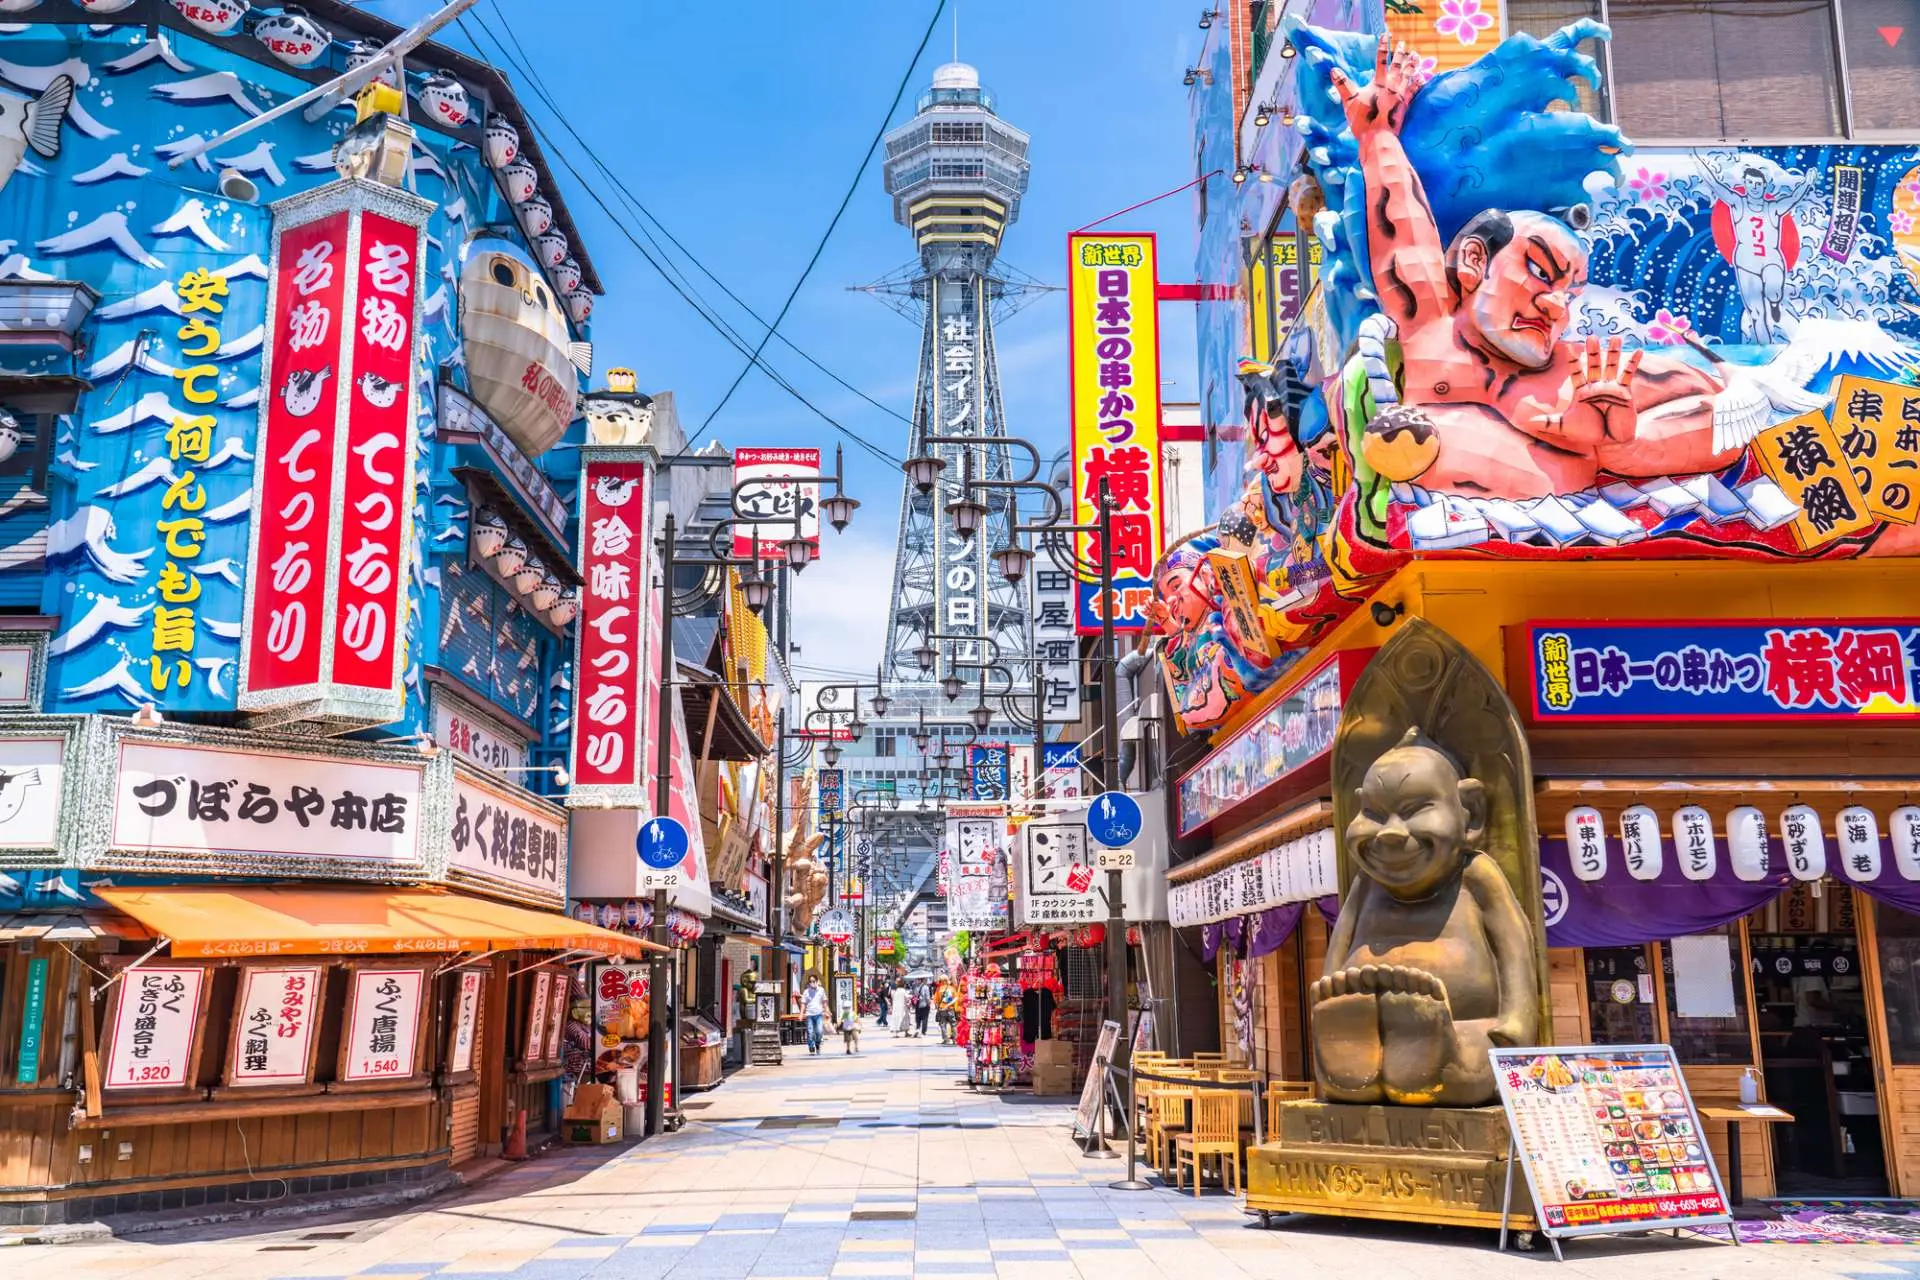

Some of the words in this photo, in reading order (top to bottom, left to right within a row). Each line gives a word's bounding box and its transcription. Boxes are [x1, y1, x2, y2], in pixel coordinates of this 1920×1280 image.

[1828, 170, 1858, 254] 開運招福
[1082, 243, 1142, 266] 新世界
[289, 240, 333, 353] 名物
[361, 240, 411, 352] 名物
[1096, 270, 1134, 443] 日本一の串かつ
[1840, 389, 1883, 495] 串かつ
[150, 267, 229, 691] 安うて何んでも旨い
[1084, 446, 1152, 582] 横綱
[266, 429, 322, 663] てっちり
[342, 431, 400, 663] てっちり
[585, 514, 633, 775] 珍味てっちり
[1543, 635, 1571, 707] 新世界
[1574, 648, 1761, 694] 日本一の串かつ
[1764, 630, 1907, 705] 横綱
[132, 777, 408, 835] づぼらや本店
[451, 792, 558, 883] ふぐ料理専門
[1579, 825, 1600, 872] 串かつ
[1624, 823, 1644, 871] 豚バラ
[1688, 823, 1708, 872] ホルモン
[1787, 822, 1809, 872] 砂ずり
[1848, 824, 1872, 873] 海老
[1031, 899, 1039, 907] 1F
[1031, 910, 1039, 919] 2F
[162, 974, 185, 1014] ふぐ
[277, 976, 306, 1039] おみやげ
[369, 978, 402, 1053] ふぐ唐揚
[599, 969, 650, 1001] 串か
[27, 1037, 34, 1048] 5
[131, 975, 163, 1059] にぎり盛合せ
[244, 1007, 272, 1071] ふぐ料理
[127, 1066, 171, 1082] 1,320
[362, 1060, 399, 1074] 1,540
[1305, 1114, 1466, 1151] BILLIKEN
